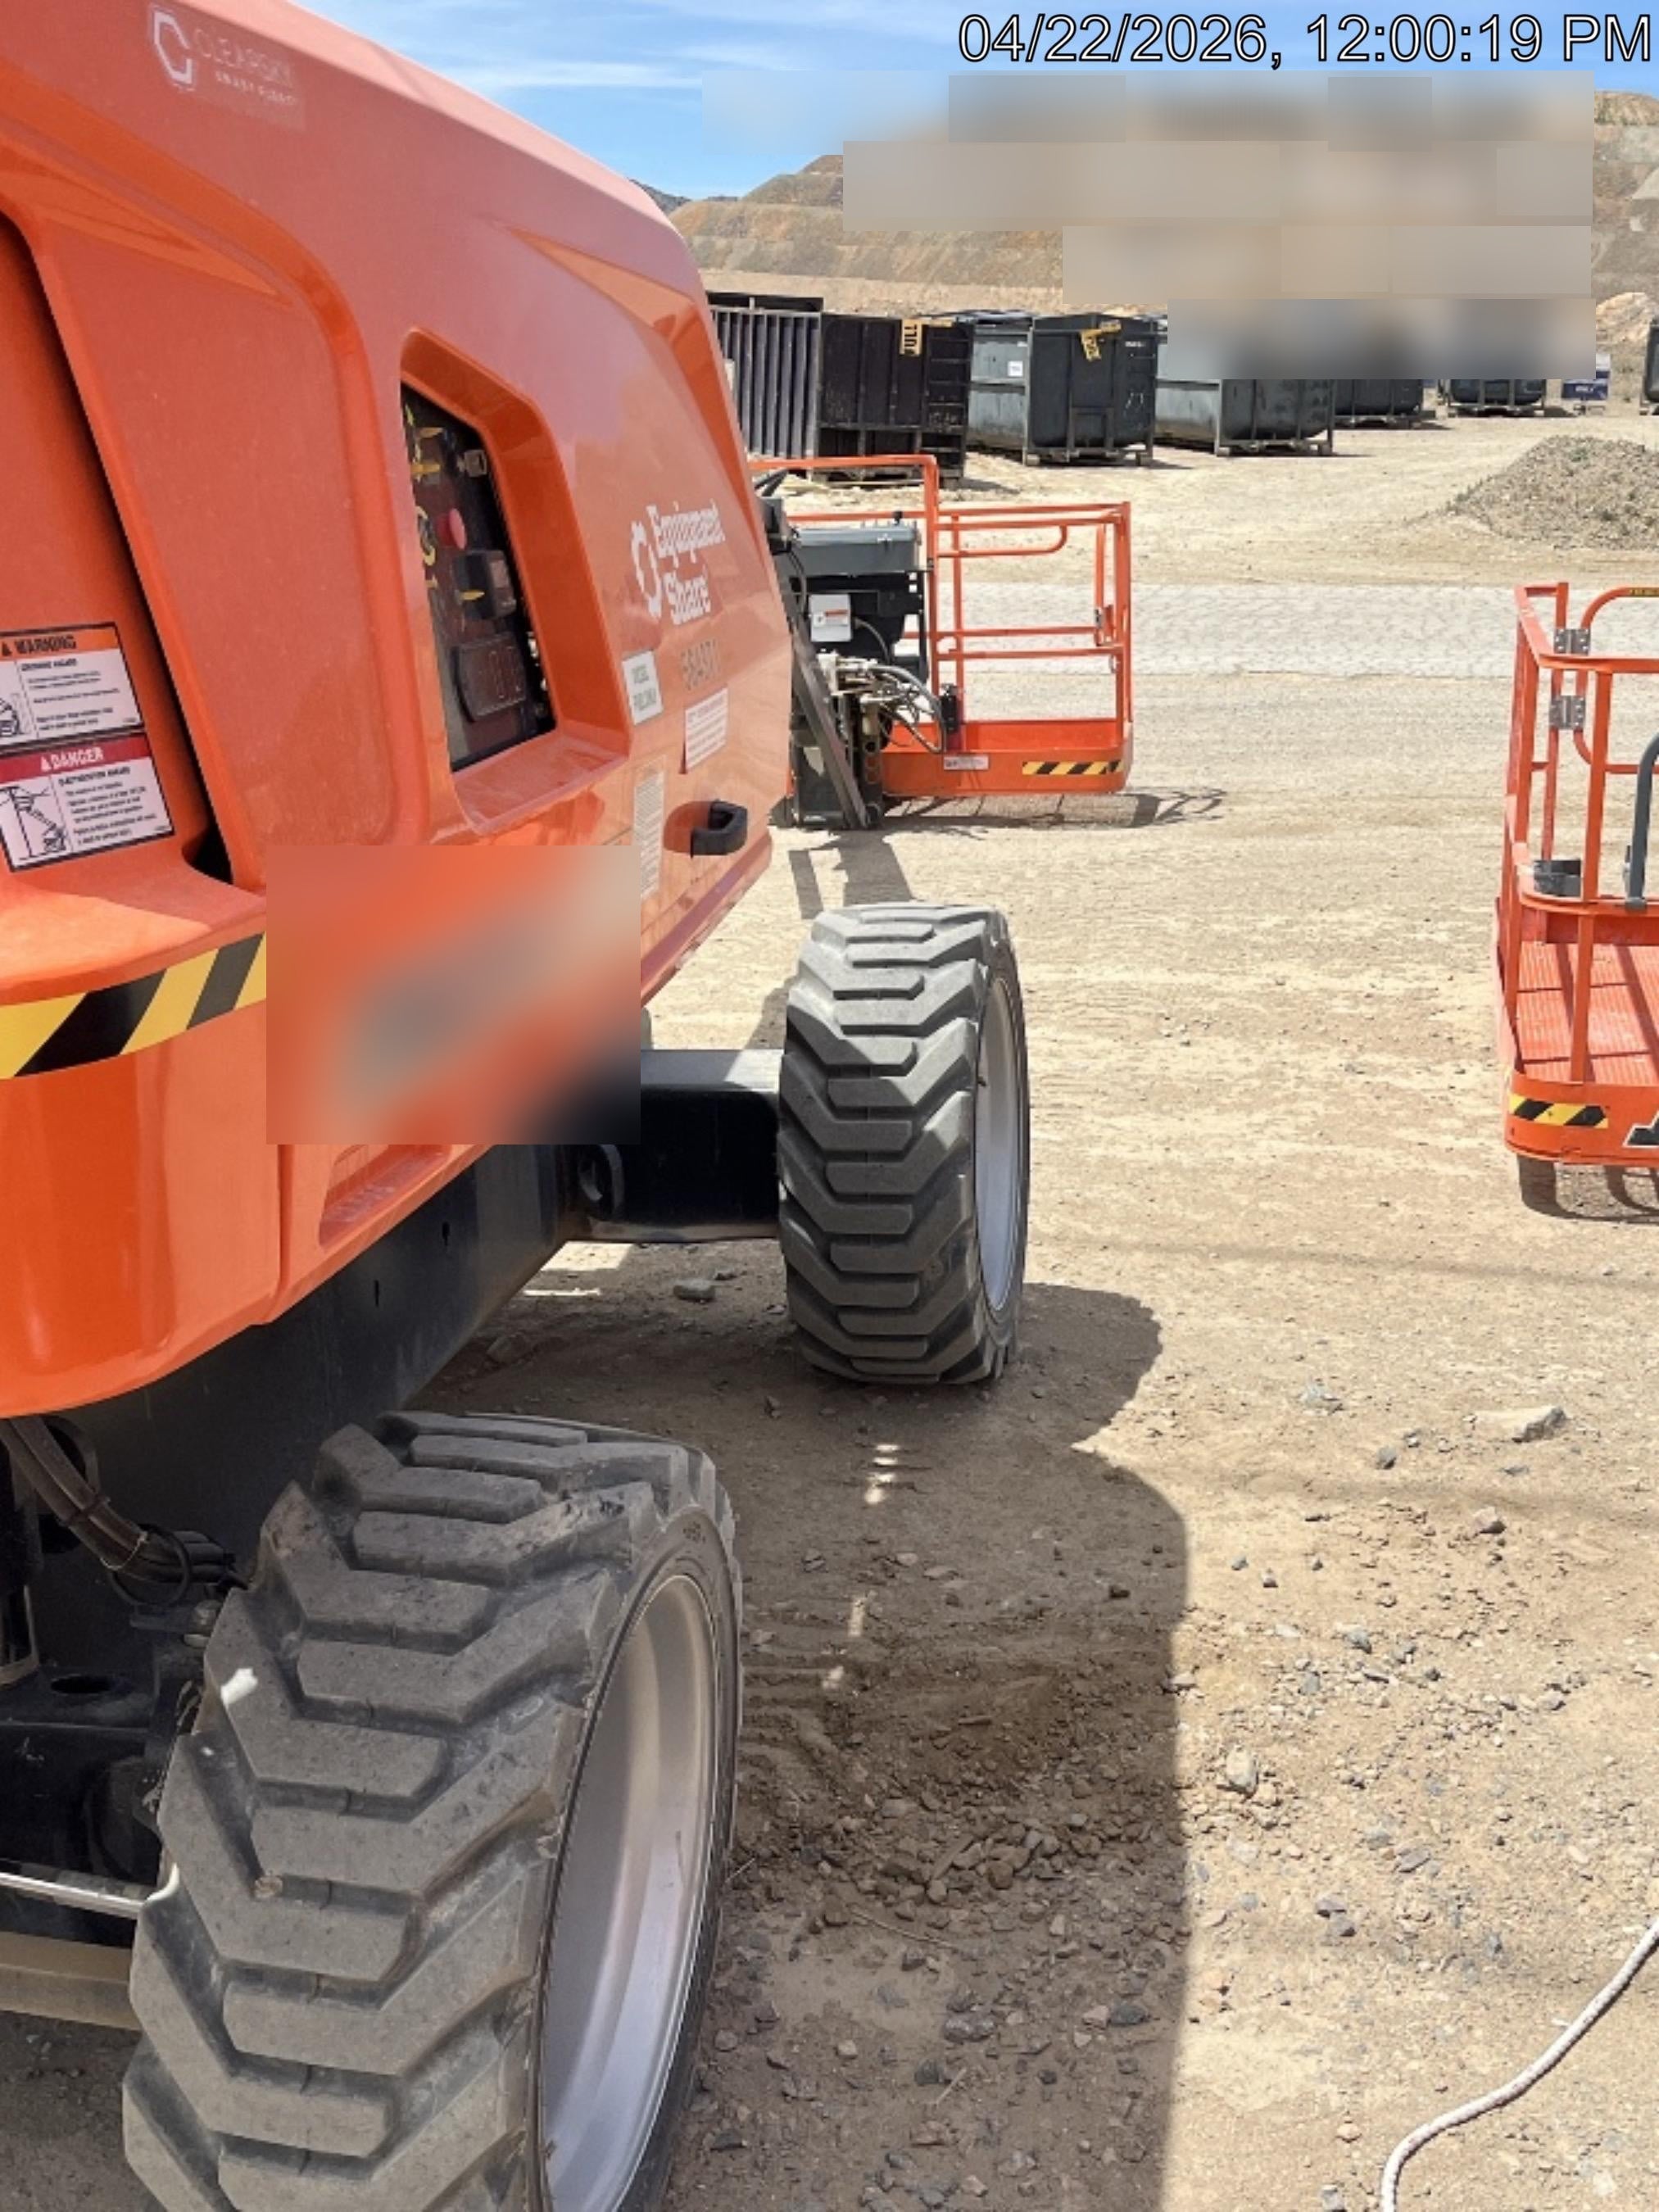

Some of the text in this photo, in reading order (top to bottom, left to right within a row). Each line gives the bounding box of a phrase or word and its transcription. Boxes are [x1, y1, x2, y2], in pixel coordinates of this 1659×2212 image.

[663, 564, 711, 625] Share
[14, 635, 77, 654] WARNING
[51, 746, 104, 770] DANGER
